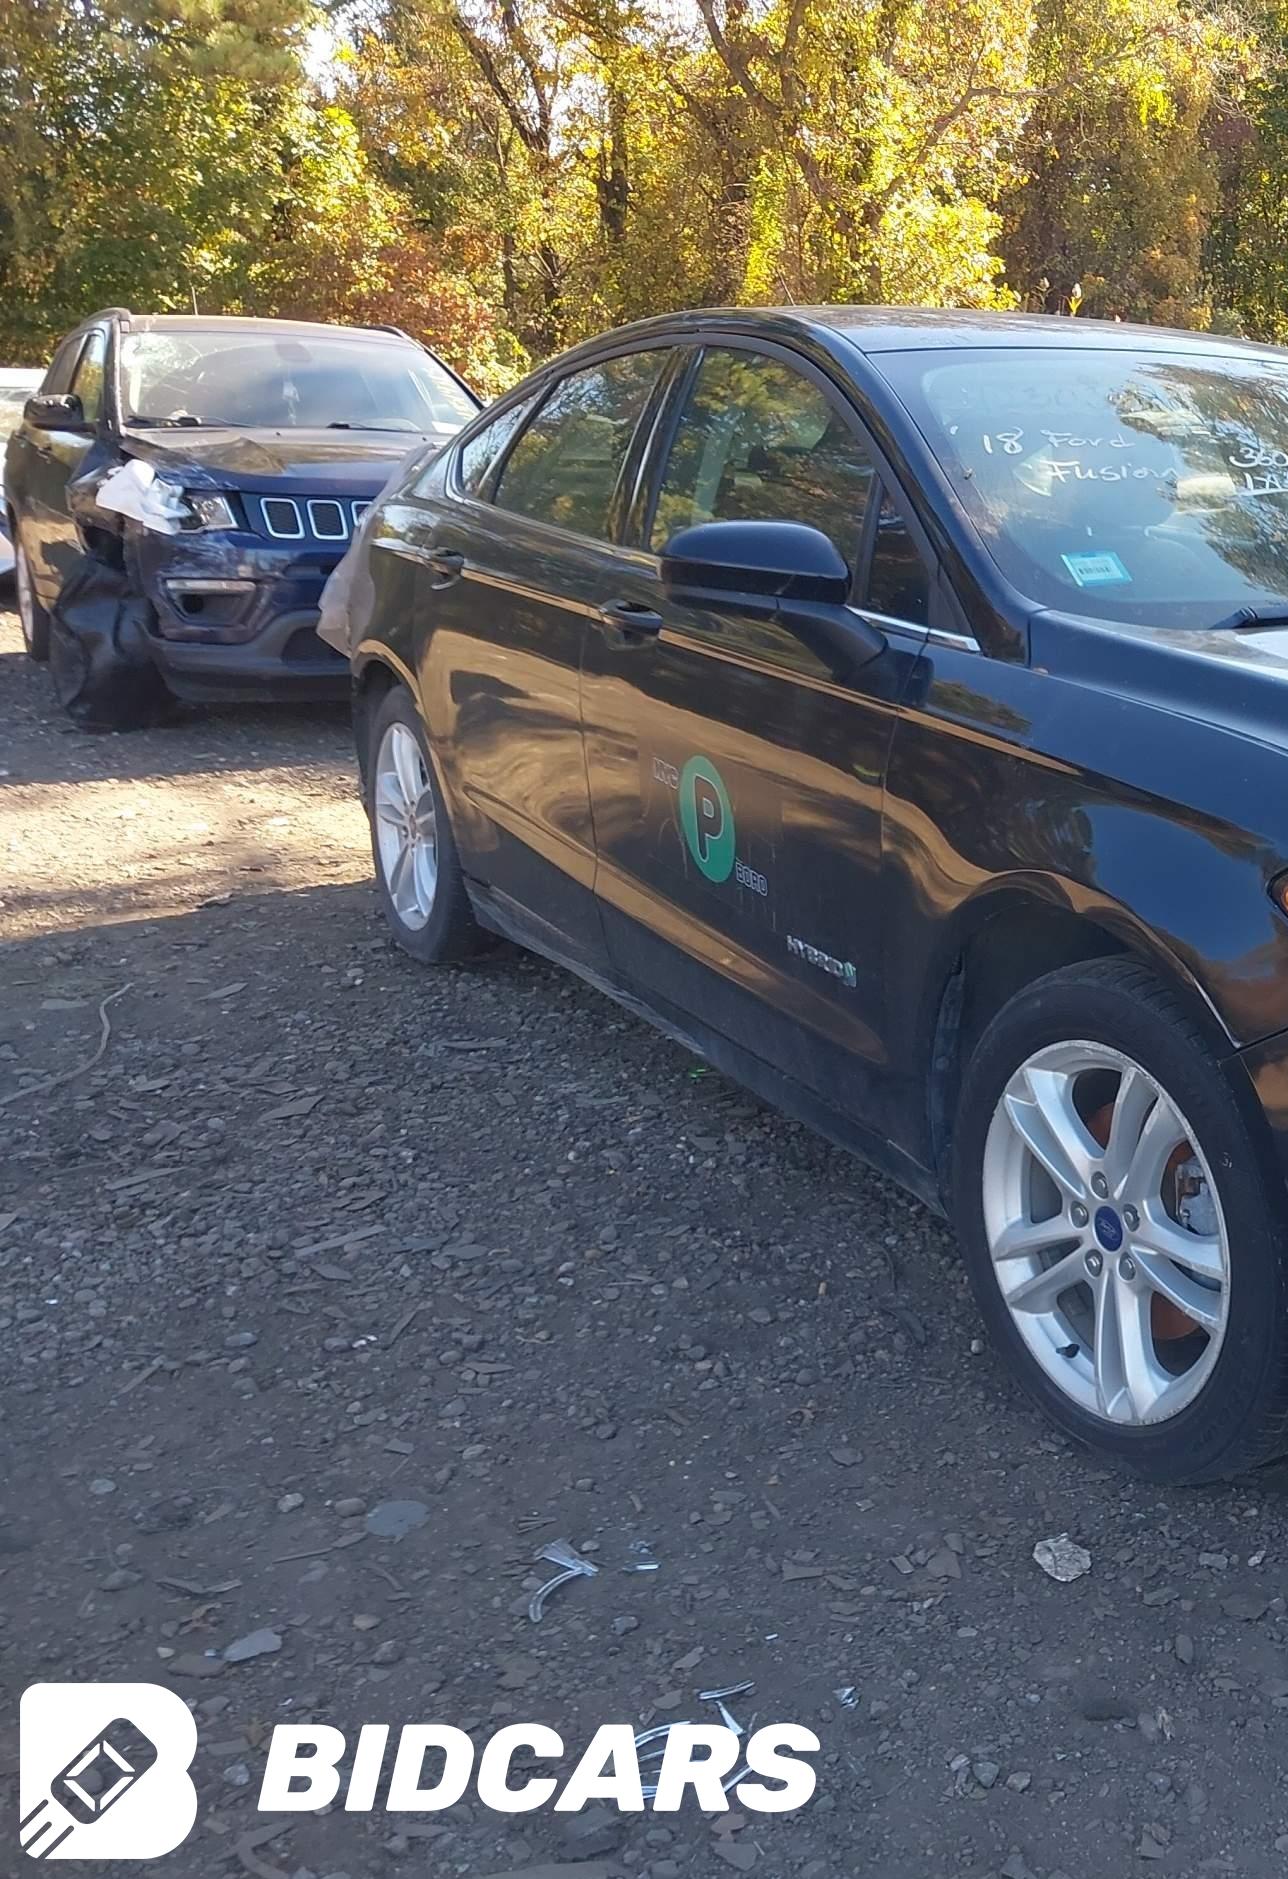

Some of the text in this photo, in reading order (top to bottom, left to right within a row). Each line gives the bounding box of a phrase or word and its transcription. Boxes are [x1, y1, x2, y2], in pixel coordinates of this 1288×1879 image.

[983, 426, 1136, 454] 18 Ford
[1037, 458, 1178, 483] Fusion
[692, 773, 725, 863] P
